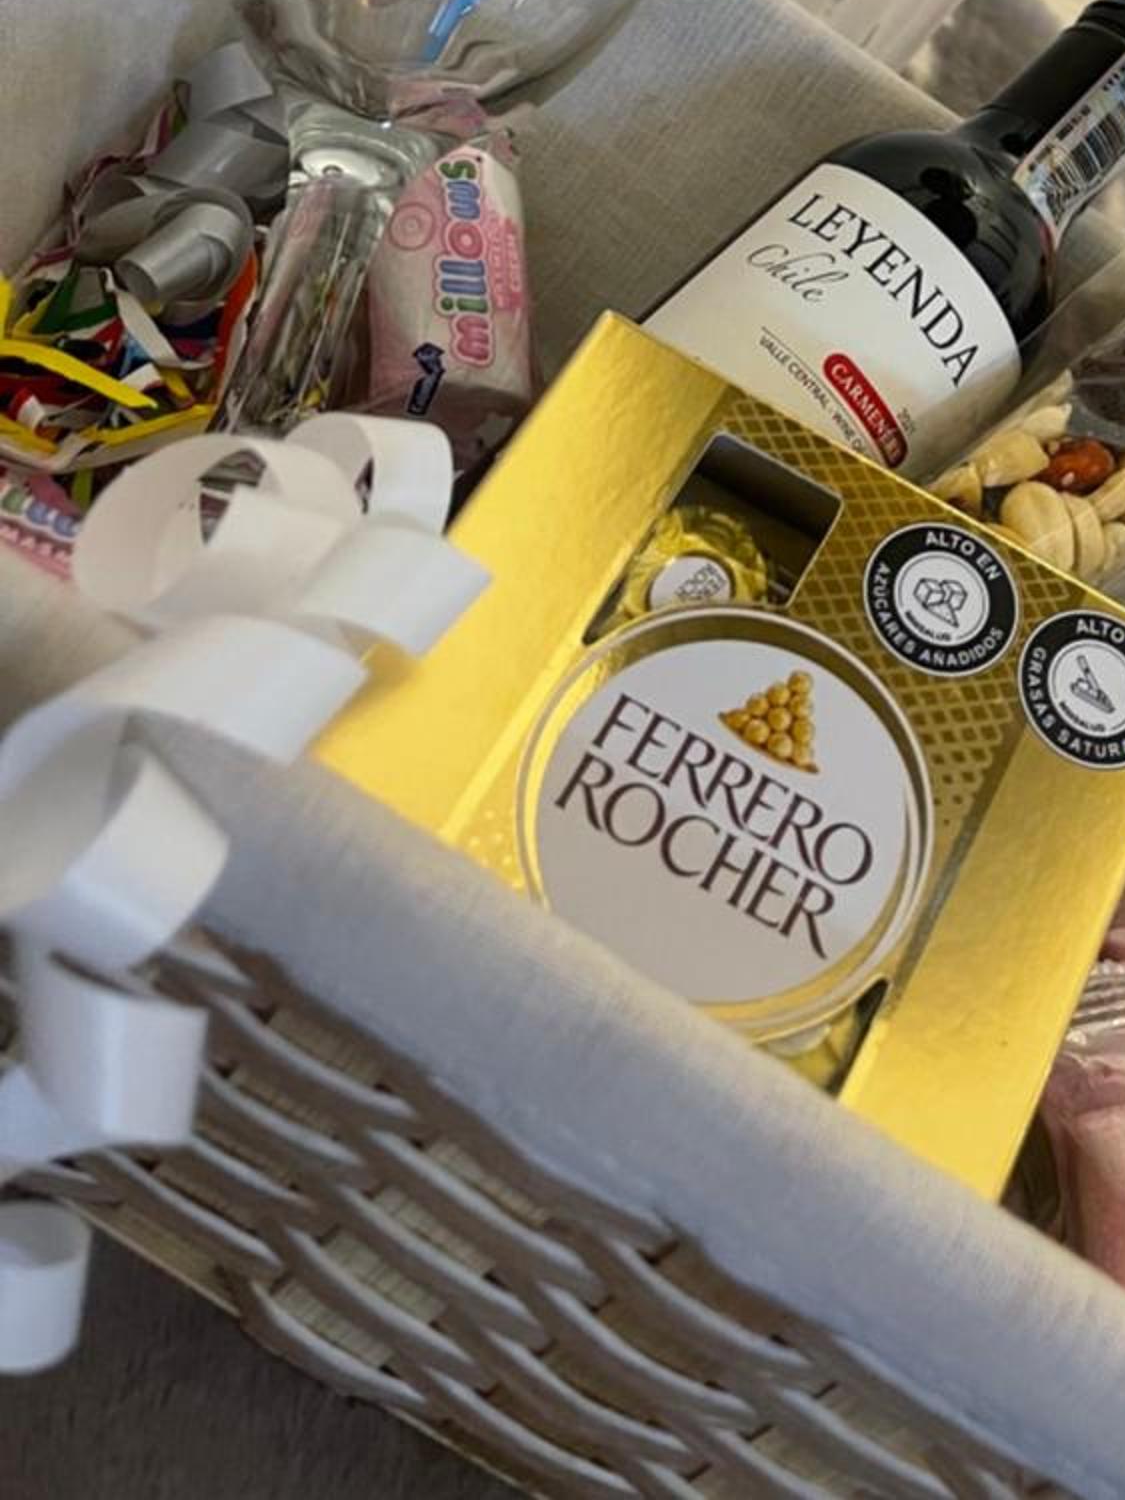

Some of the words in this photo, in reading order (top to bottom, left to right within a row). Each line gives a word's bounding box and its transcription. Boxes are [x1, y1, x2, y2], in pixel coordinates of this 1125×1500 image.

[747, 242, 849, 304] Chile
[787, 192, 980, 388] LEYENDA
[758, 335, 790, 367] VALLE
[787, 356, 832, 410] CENTRAL
[924, 530, 974, 558] ALTO
[974, 552, 1003, 582] EN
[871, 561, 914, 656] AZUCARES
[919, 626, 1004, 668] AÑADIDOS
[1075, 617, 1125, 645] ALTO
[1027, 646, 1057, 729] GRASAS
[593, 692, 874, 886] FERRERO
[554, 753, 837, 960] ROCHER
